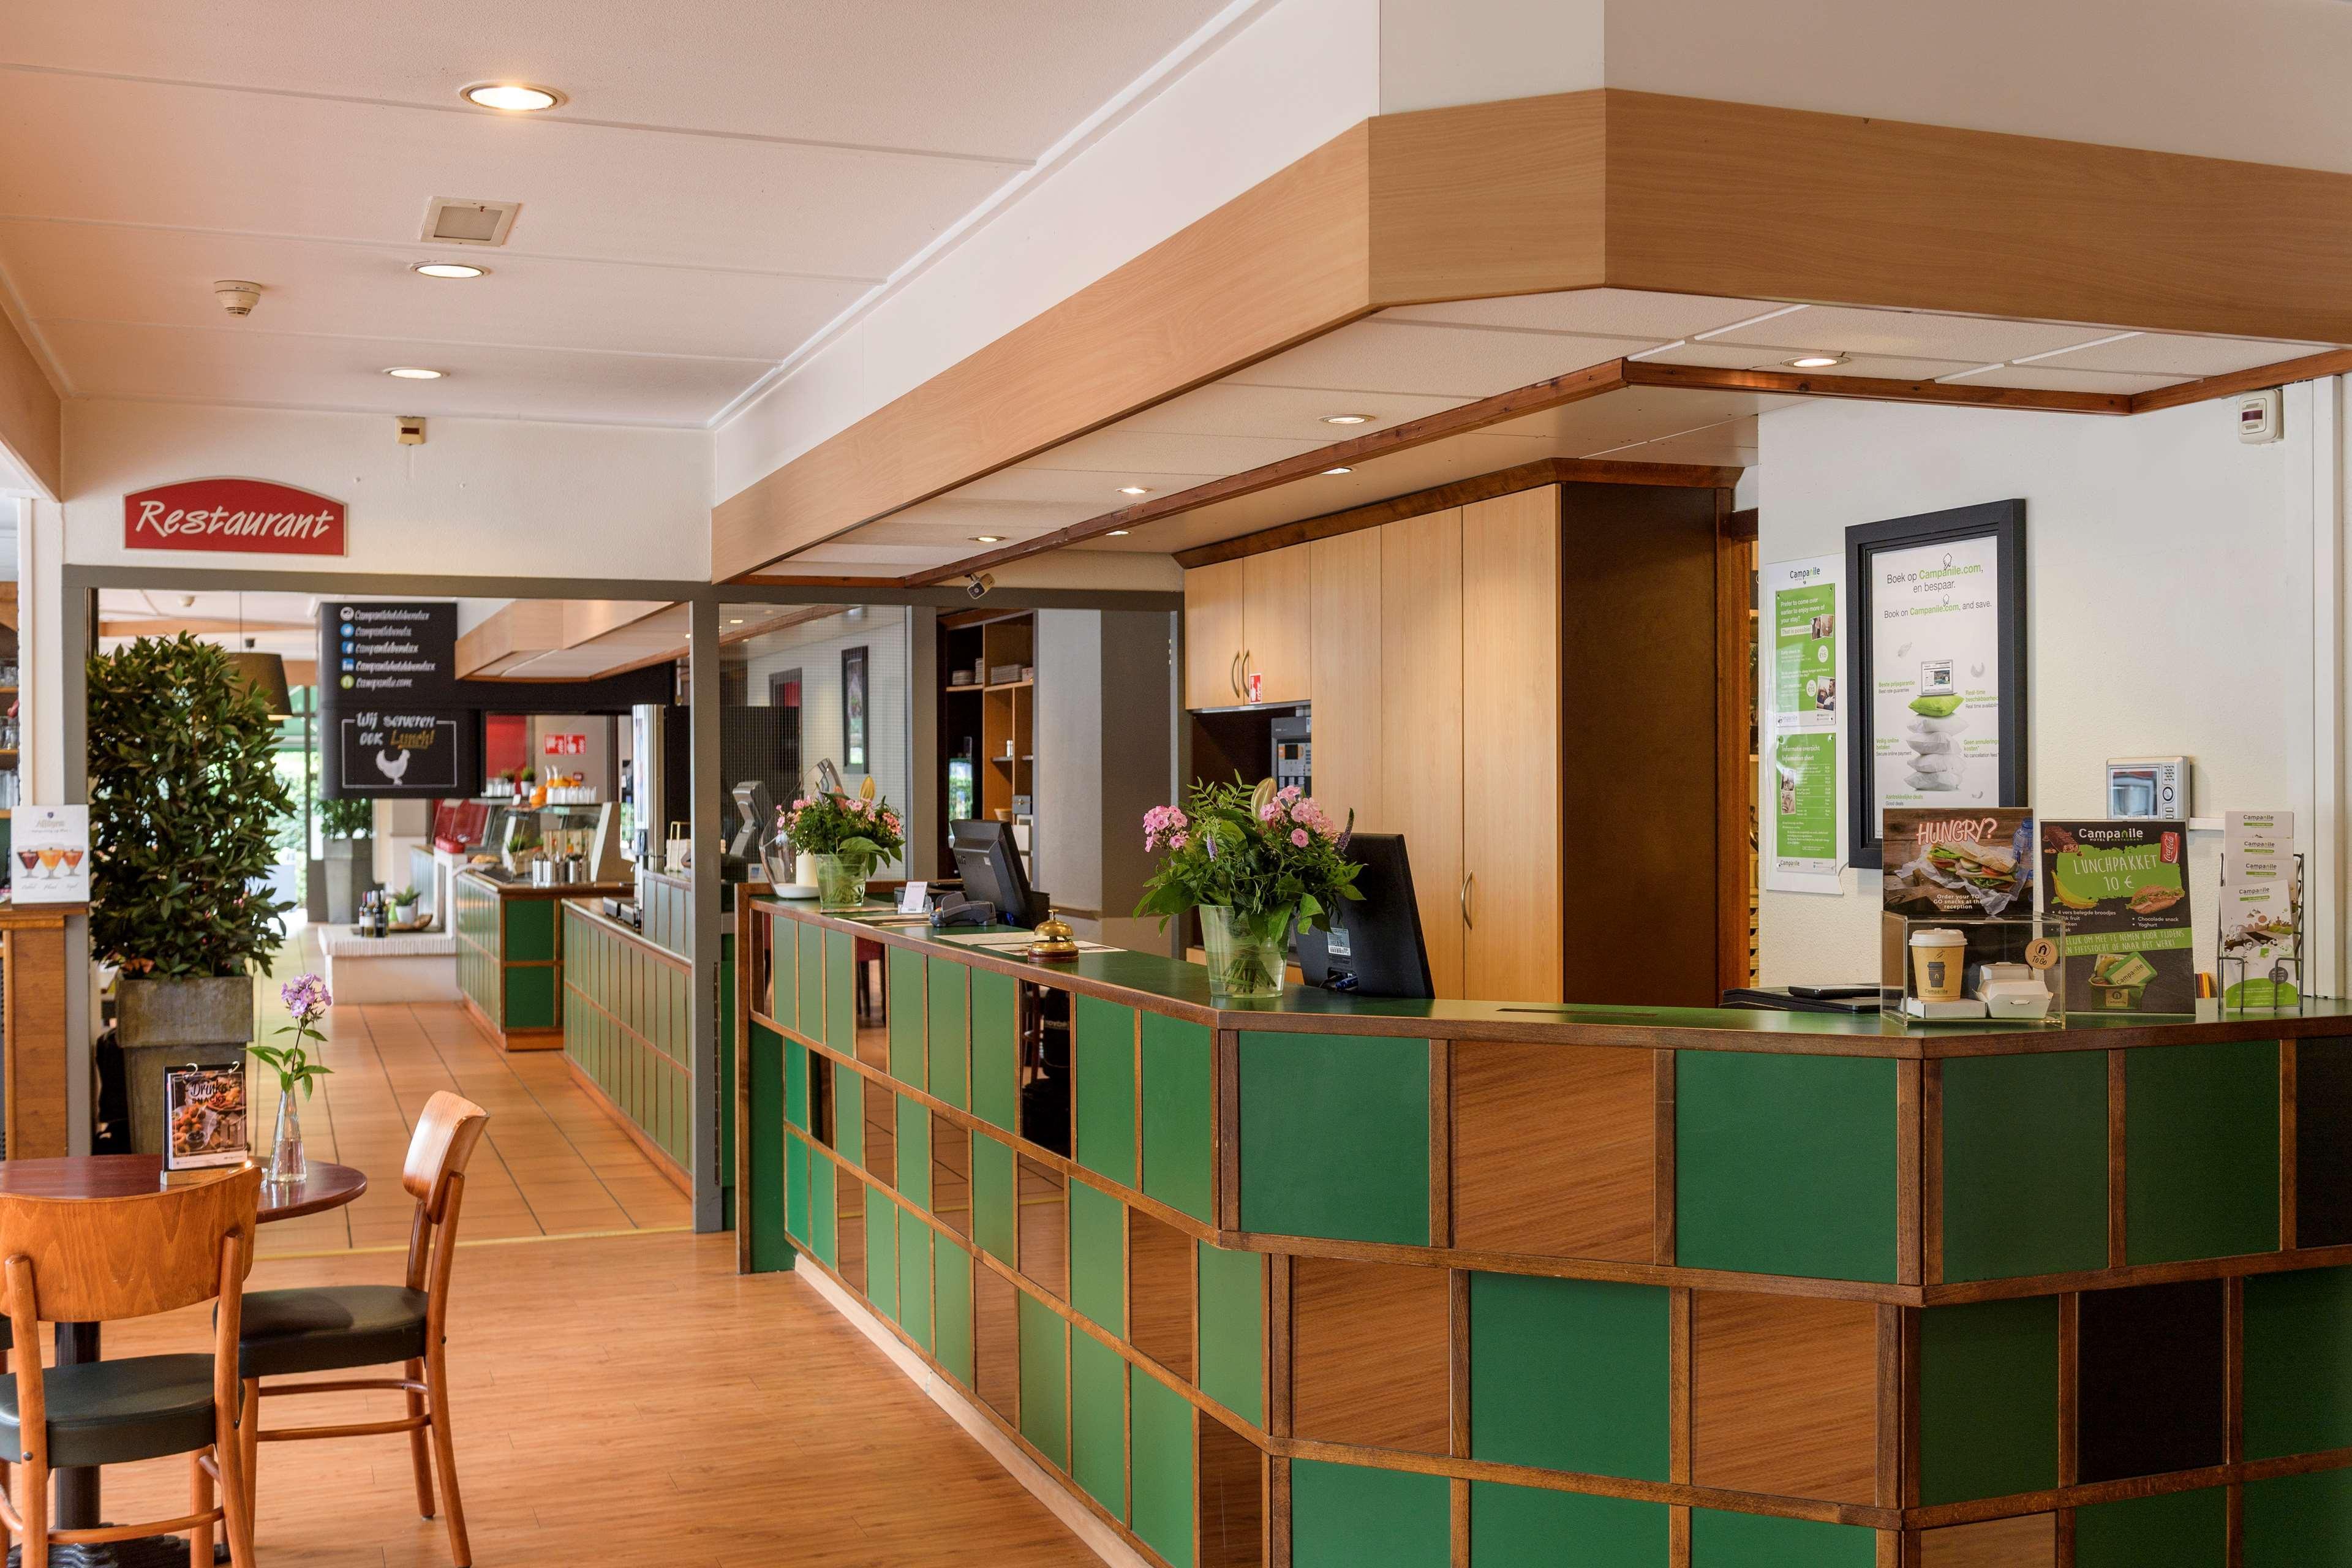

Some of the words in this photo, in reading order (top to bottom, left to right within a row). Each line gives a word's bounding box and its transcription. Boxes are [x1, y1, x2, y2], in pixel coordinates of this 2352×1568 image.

[135, 500, 334, 539] Restaurant
[1790, 567, 1820, 579] Campanile
[1887, 573, 1905, 584] Boek
[1907, 573, 1917, 582] op
[1919, 564, 1983, 579] Campanile.com,
[1924, 581, 1956, 592] bespaar.
[1910, 604, 1961, 616] Campanile.com,
[1962, 601, 1974, 610] and
[1975, 600, 1992, 609] save.
[356, 710, 378, 729] Wij
[383, 715, 435, 728] serveren
[1917, 818, 1997, 845] HUNGRY?
[2079, 828, 2143, 841] Campanile
[2073, 854, 2157, 875] LUNCHPAKKET
[2103, 876, 2119, 891] 10
[2124, 875, 2135, 889] €
[2084, 935, 2093, 943] OM
[2095, 934, 2108, 943] MEE
[2119, 932, 2140, 941] NEMEN
[2143, 931, 2157, 940] VOOR
[2160, 929, 2185, 938] TIJDENS
[2075, 944, 2109, 954] FIETSTOCHT
[2112, 943, 2119, 951] OF
[2122, 941, 2140, 951] NAAR
[2142, 940, 2154, 949] HET
[2156, 939, 2175, 948] WERK!
[2116, 963, 2144, 986] Campanile
[190, 1080, 228, 1096] Drinks
